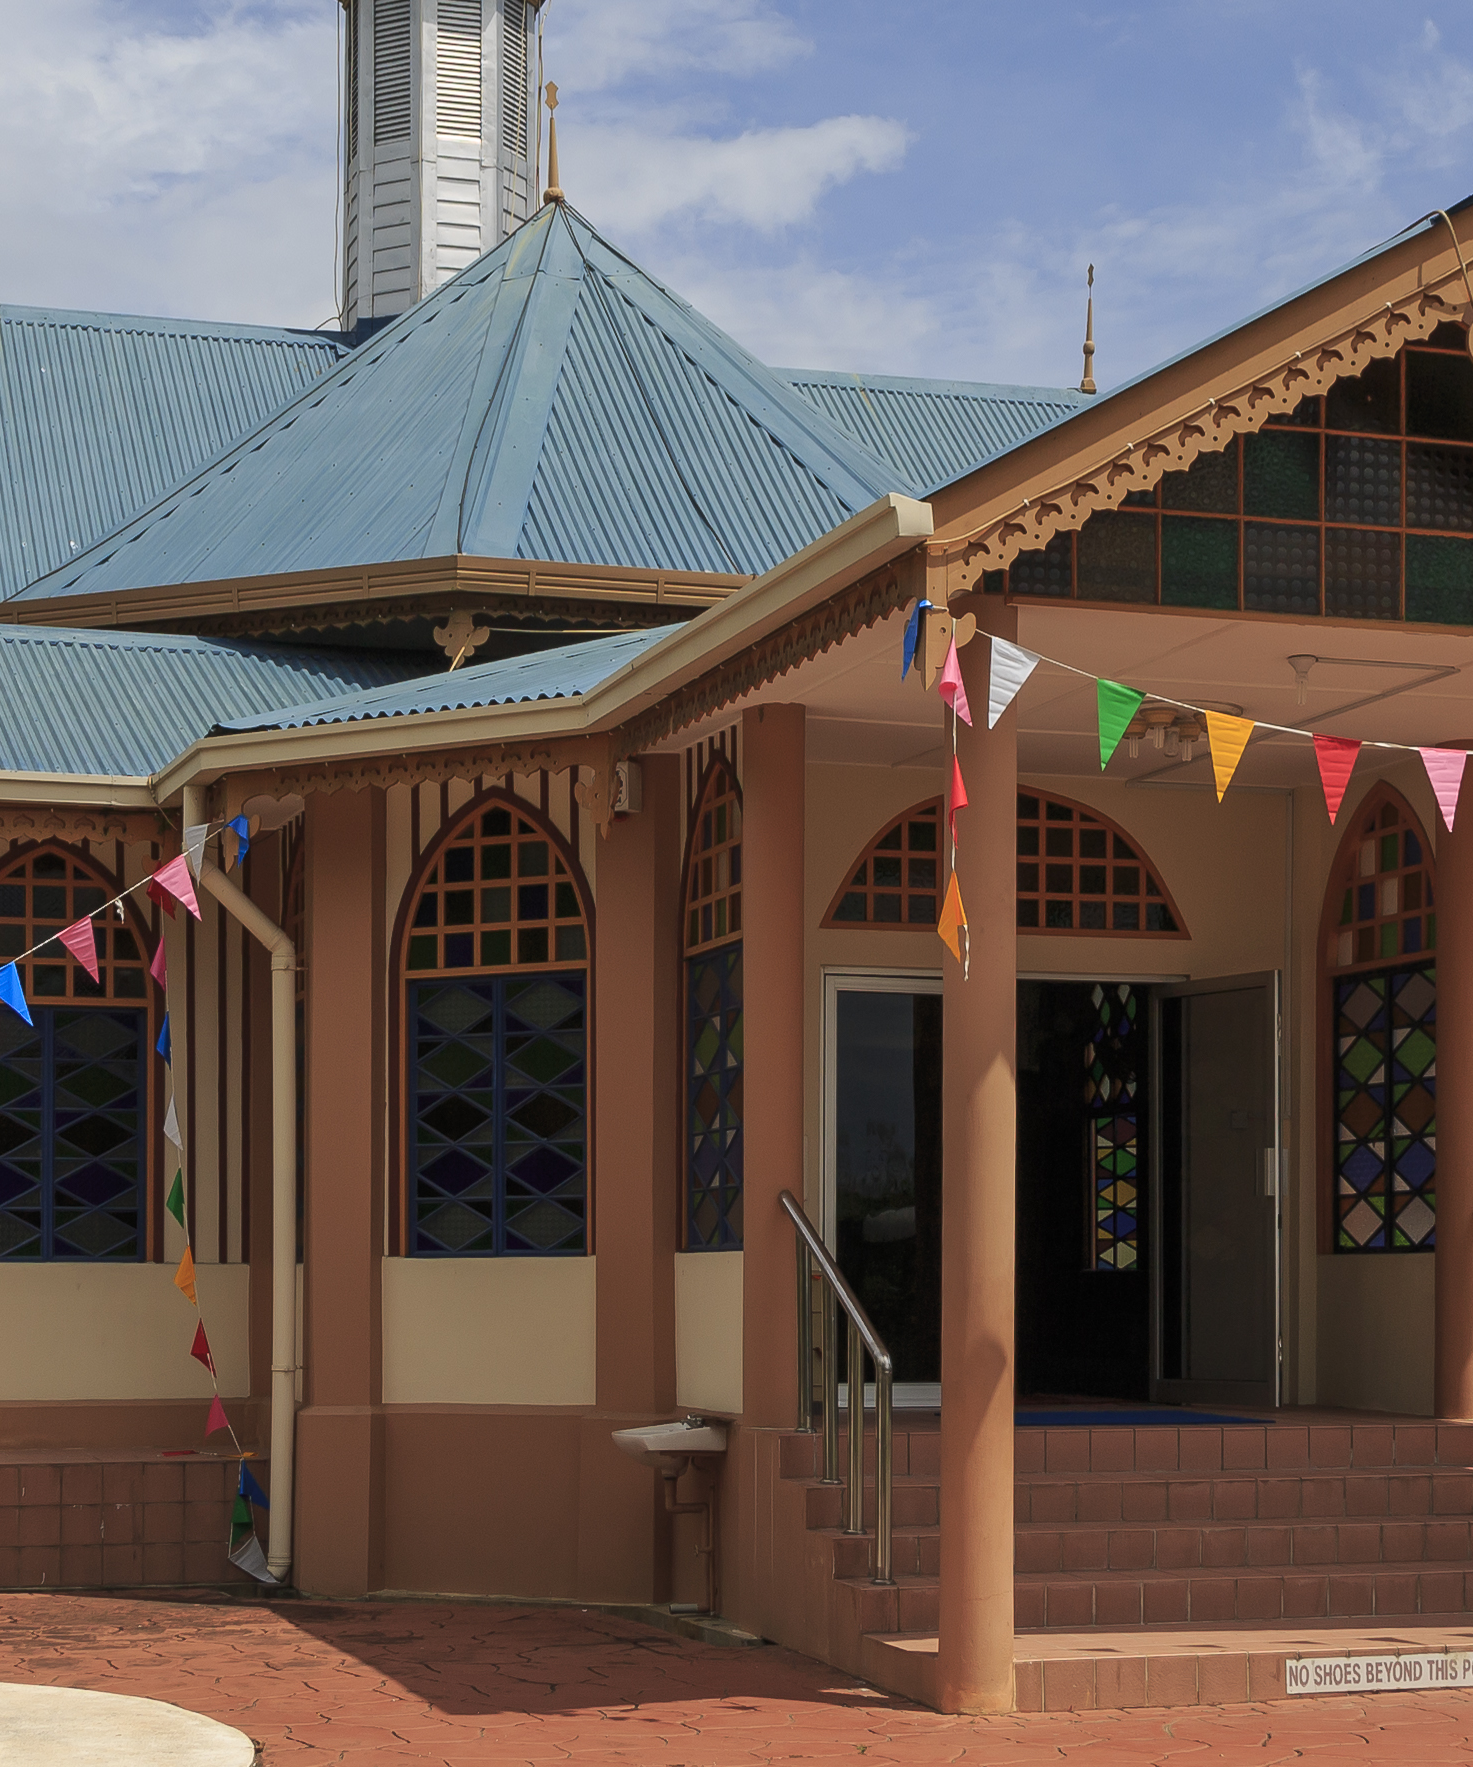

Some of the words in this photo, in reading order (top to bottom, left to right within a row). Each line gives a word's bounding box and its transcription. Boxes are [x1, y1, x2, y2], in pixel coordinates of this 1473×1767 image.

[1289, 1664, 1310, 1687] NO
[1314, 1662, 1361, 1686] SHOES
[1365, 1660, 1423, 1684] BEYOND
[1427, 1658, 1458, 1681] THIS
